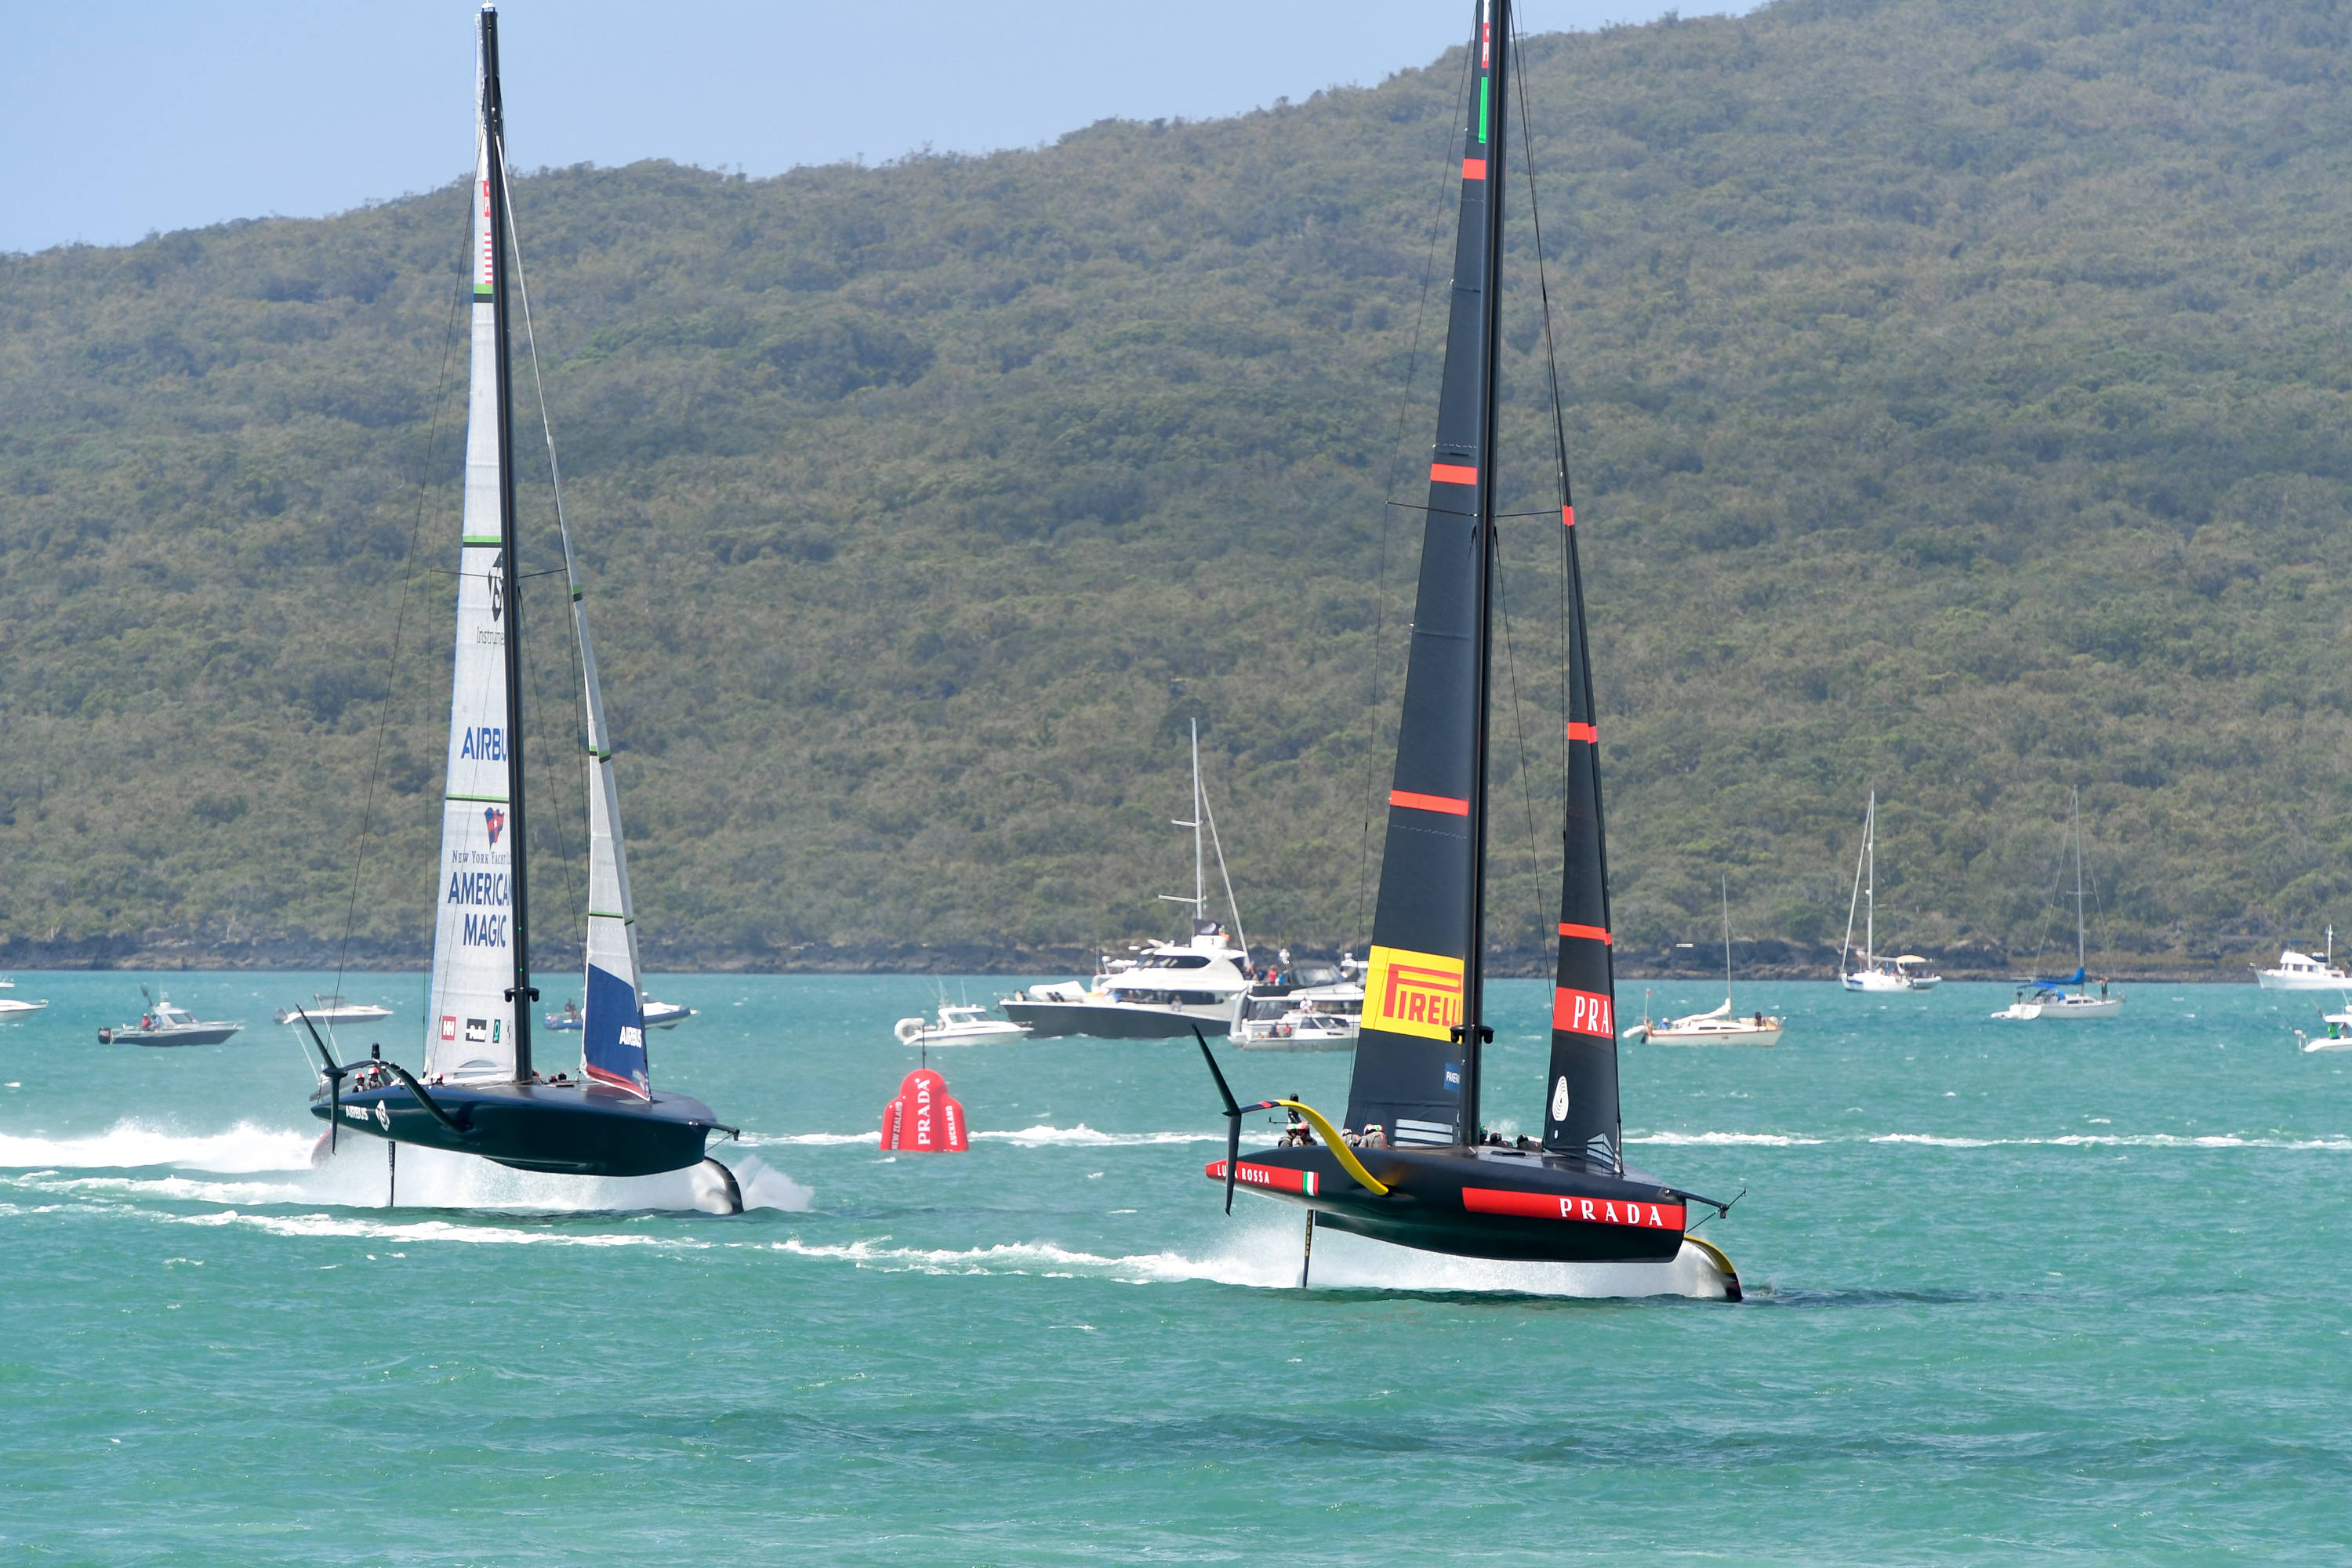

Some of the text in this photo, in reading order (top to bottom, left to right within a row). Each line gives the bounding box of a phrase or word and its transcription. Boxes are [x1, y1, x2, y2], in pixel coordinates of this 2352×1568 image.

[461, 726, 507, 762] AIRBU
[463, 913, 506, 948] MAGIC
[1383, 963, 1462, 1027] PIRELLI
[1573, 995, 1612, 1034] PRA
[619, 1025, 642, 1048] AIRBUS
[346, 1105, 369, 1121] AIRBUS
[917, 1079, 931, 1145] PRADA
[946, 1105, 958, 1146] AUCKLAND
[1217, 1164, 1269, 1184] LUA ROSSA
[1559, 1198, 1663, 1226] PRADA
